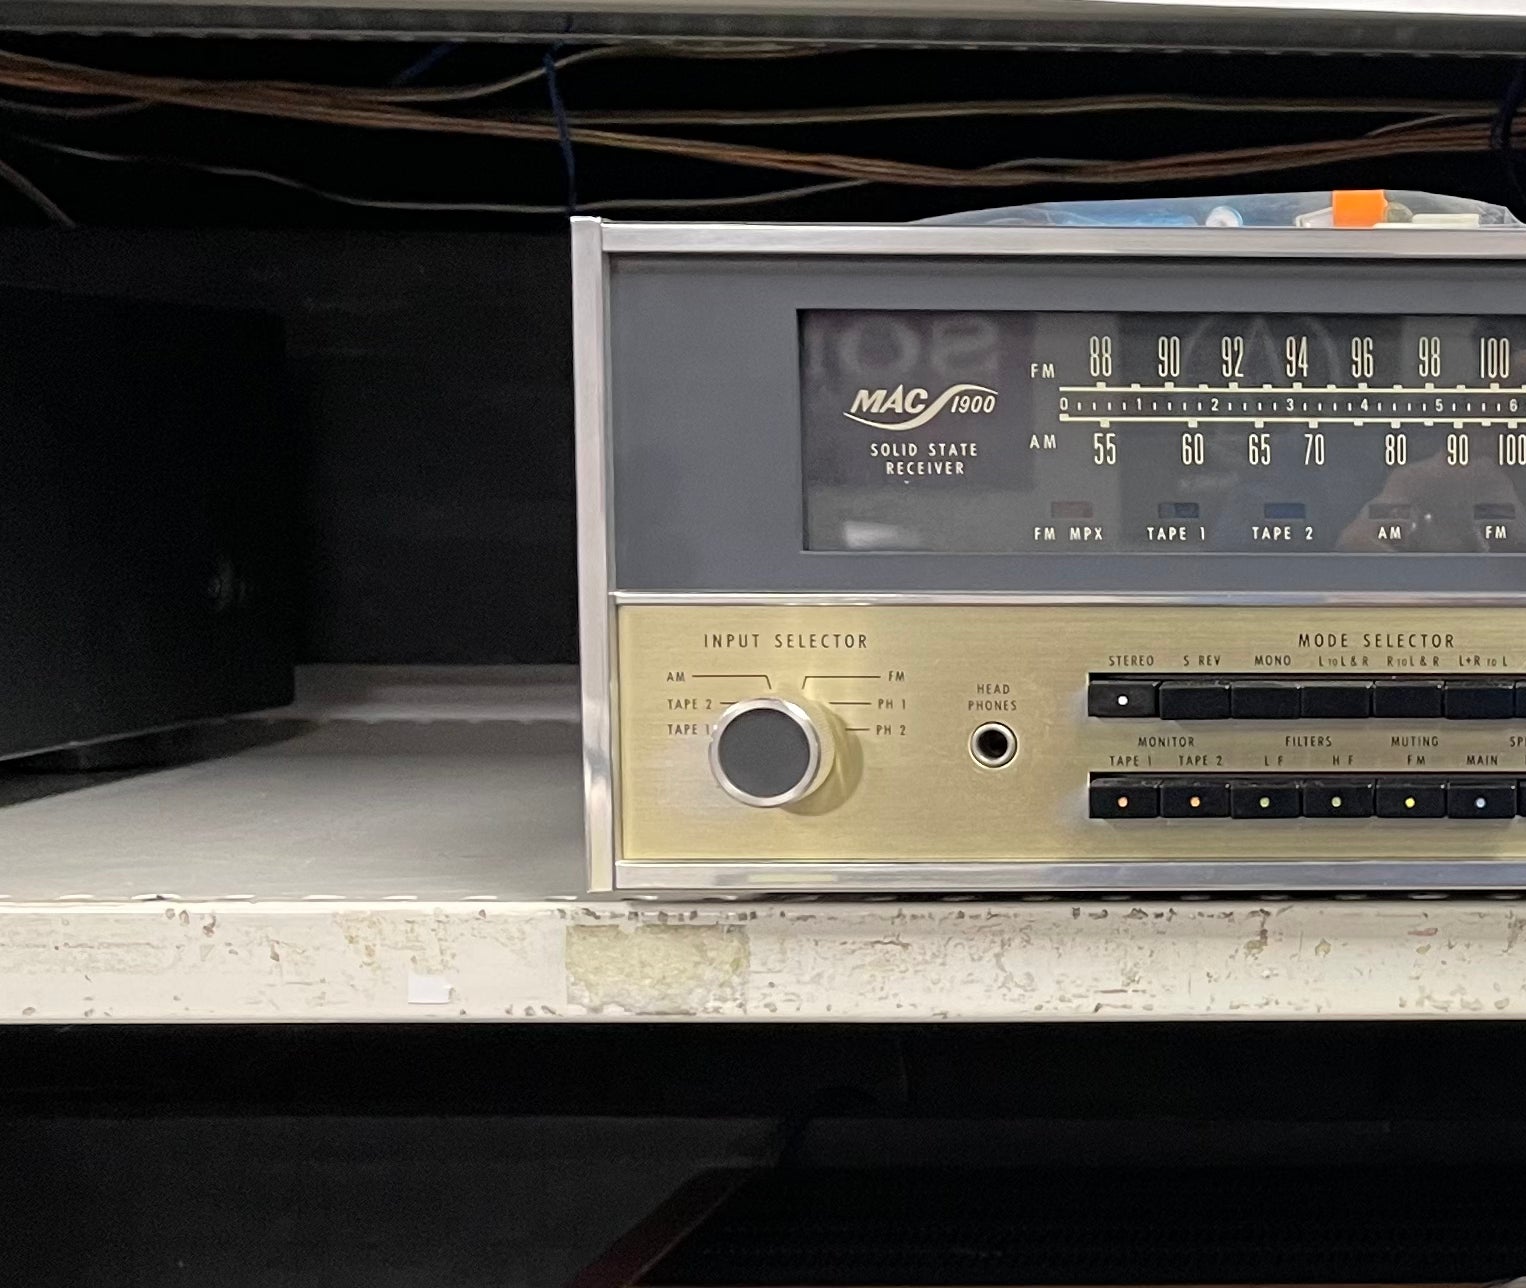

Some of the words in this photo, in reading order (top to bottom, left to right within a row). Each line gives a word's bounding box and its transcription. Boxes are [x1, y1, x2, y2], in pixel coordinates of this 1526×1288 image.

[1030, 363, 1056, 379] FM
[1089, 336, 1112, 380] 88
[1158, 336, 1181, 380] 90
[1221, 336, 1244, 380] 92
[1285, 336, 1309, 380] 94
[1351, 336, 1374, 380] 96
[1418, 336, 1441, 380] 98
[1480, 336, 1510, 380] 100
[850, 385, 929, 414] MAC
[950, 394, 997, 415] 1900
[1059, 398, 1069, 412] 0
[1136, 398, 1142, 412] 1
[1210, 398, 1220, 412] 2
[1286, 398, 1295, 412] 3
[1360, 398, 1368, 412] 4
[1435, 398, 1443, 412] 5
[1509, 398, 1518, 412] 6
[870, 442, 919, 457] SOLID
[928, 442, 978, 457] STATE
[1029, 435, 1058, 450] AM
[1092, 432, 1117, 467] 55
[1181, 432, 1204, 467] 60
[1248, 432, 1272, 467] 65
[1304, 432, 1326, 467] 70
[1385, 432, 1407, 467] 80
[1447, 432, 1469, 467] 90
[886, 460, 966, 475] RECEIVER
[1033, 526, 1057, 541] FM
[1069, 526, 1104, 541] MPX
[1146, 526, 1187, 541] TAPE
[1199, 526, 1206, 541] 1
[1251, 526, 1292, 541] TAPE
[1305, 526, 1314, 541] 2
[1377, 526, 1402, 540] AM
[1485, 526, 1508, 540] FM
[703, 633, 760, 649] INPUT
[774, 633, 869, 649] SELECTOR
[1299, 633, 1350, 648] MODE
[1363, 633, 1455, 648] SELECTOR
[1108, 655, 1155, 667] STEREO
[1183, 655, 1190, 667] S
[1199, 655, 1221, 667] REV
[1254, 655, 1292, 667] MONO
[1318, 655, 1324, 667] L
[1340, 655, 1346, 667] L
[1350, 655, 1357, 667] &
[1362, 655, 1369, 667] R
[1387, 655, 1394, 667] R
[1410, 655, 1415, 667] L
[1420, 655, 1427, 667] &
[1433, 655, 1440, 667] R
[1459, 655, 1481, 667] L+R
[1502, 655, 1508, 667] L
[666, 671, 686, 682] AM
[888, 670, 905, 682] FM
[976, 683, 1010, 695] HEAD
[667, 698, 698, 710] TAPE
[705, 698, 712, 710] 2
[878, 698, 893, 710] PH
[901, 698, 906, 710] 1
[968, 699, 1018, 711] PHONES
[667, 723, 698, 735] TAPE
[705, 723, 710, 735] 1
[876, 724, 892, 736] PH
[899, 724, 906, 736] 2
[1138, 736, 1195, 748] MONITOR
[1285, 736, 1332, 747] FILTERS
[1391, 736, 1439, 747] MUTING
[1110, 755, 1139, 767] TAPE
[1147, 755, 1152, 767] 1
[1179, 755, 1208, 766] TAPE
[1216, 755, 1223, 766] 2
[1407, 754, 1426, 766] FM
[1466, 754, 1498, 766] MAIN
